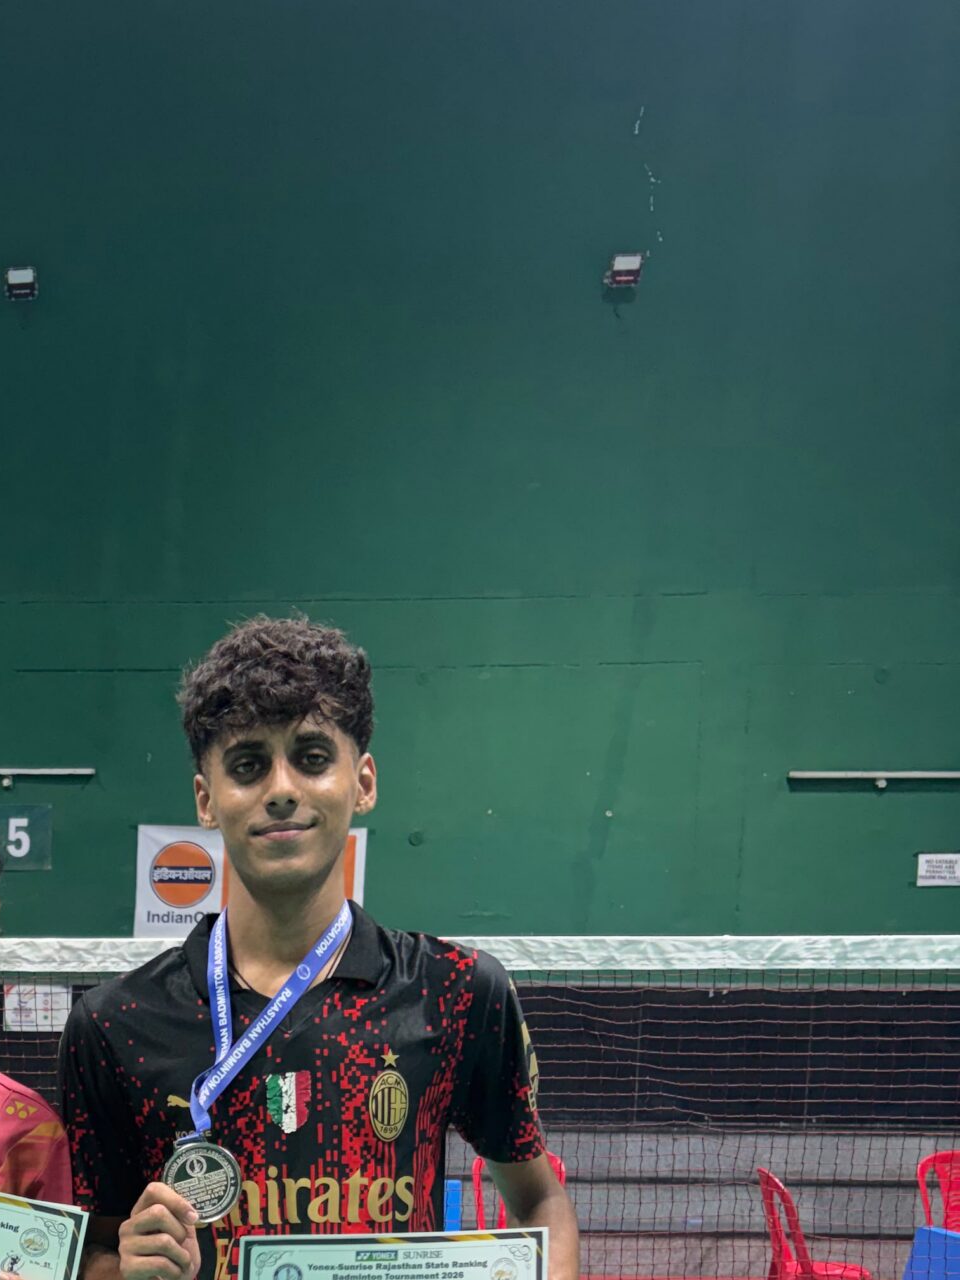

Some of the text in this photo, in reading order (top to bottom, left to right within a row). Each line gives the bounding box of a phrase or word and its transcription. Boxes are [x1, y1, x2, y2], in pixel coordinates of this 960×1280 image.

[6, 818, 31, 857] 5
[147, 911, 205, 924] IndianO
[214, 965, 228, 1026] BADMINTON
[208, 987, 292, 1090] RAJASTHAN BADMINTON
[380, 1076, 401, 1088] ACM
[380, 1126, 399, 1134] 1899
[372, 1251, 443, 1260] YONEX SUNRISE
[308, 1260, 488, 1272] Yonex-Sunrise Rajasthan State Ranking
[332, 1271, 464, 1280] Badminton Tournament 2026
